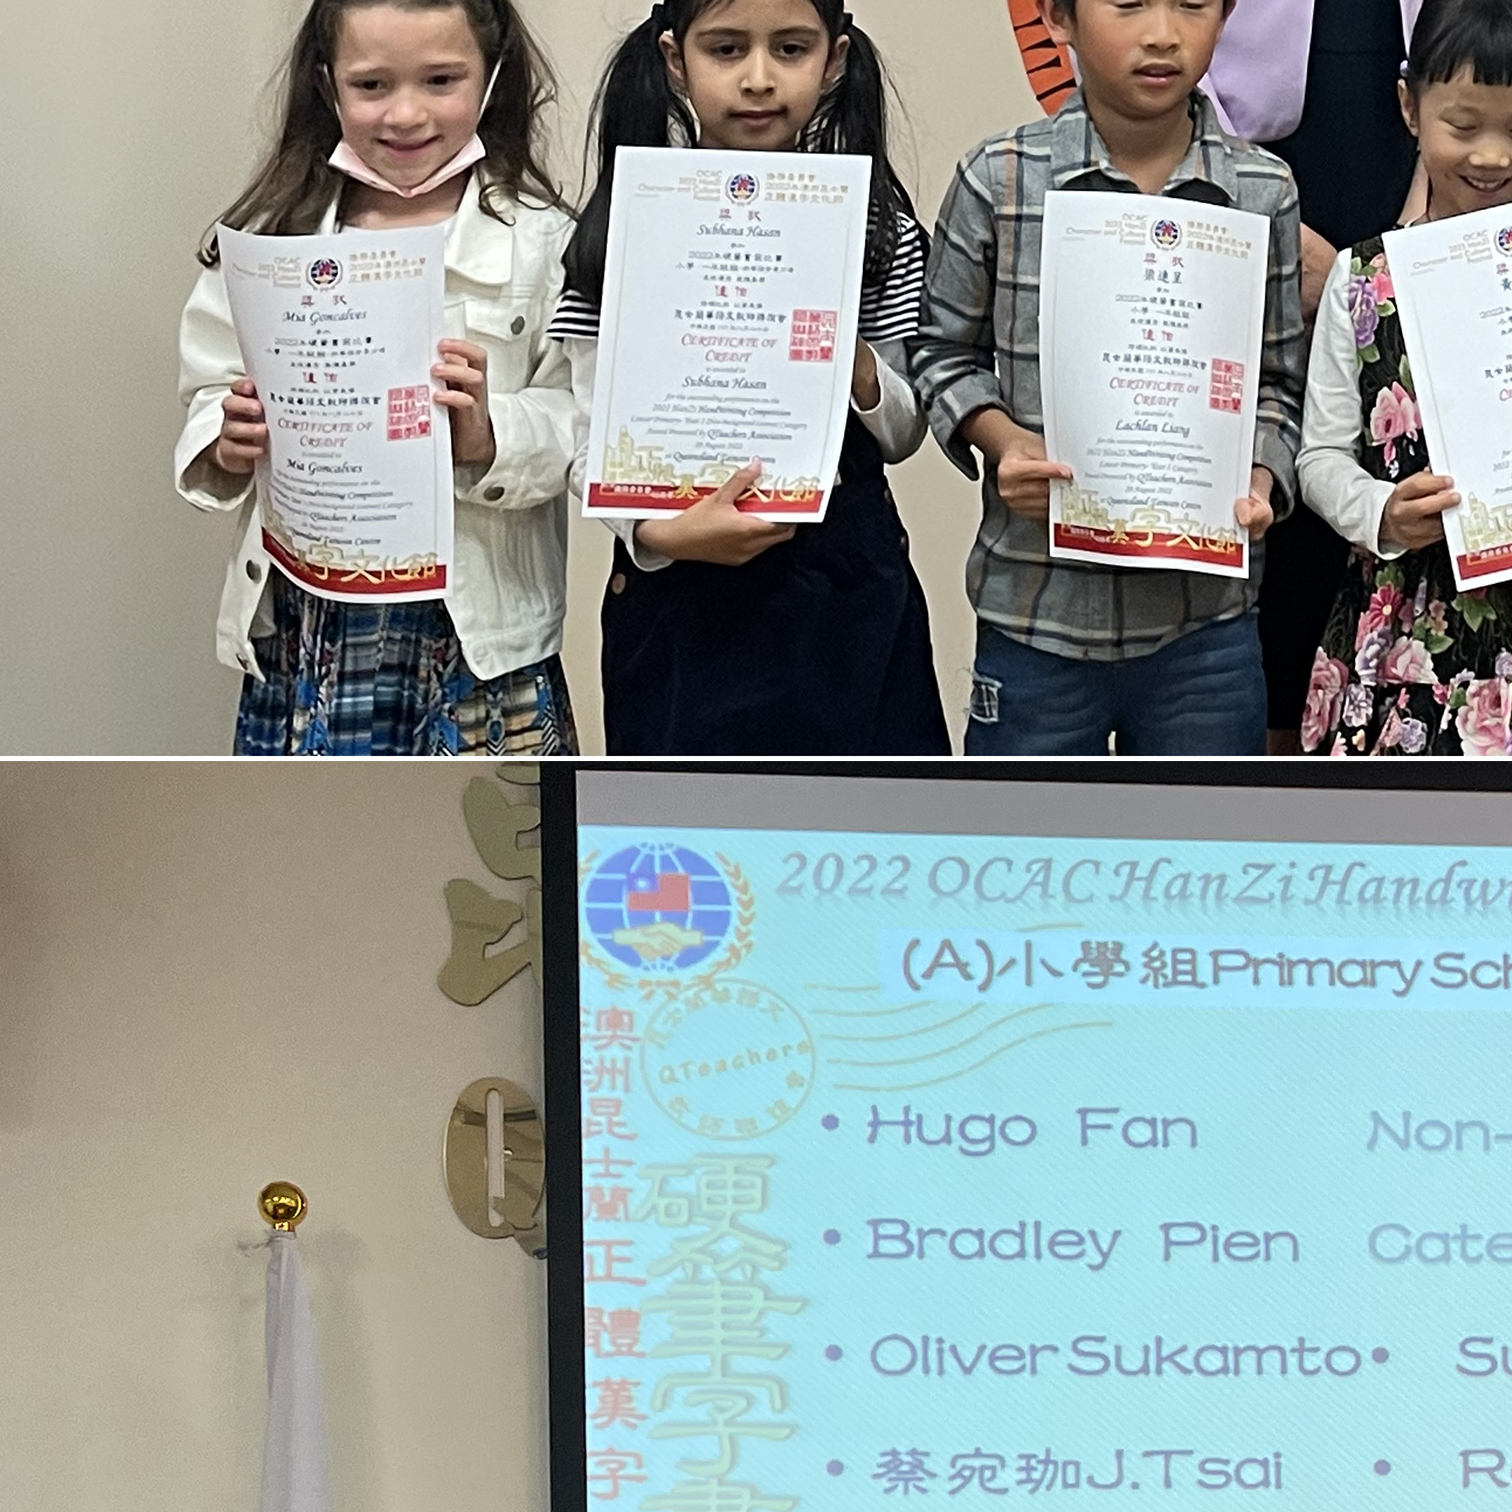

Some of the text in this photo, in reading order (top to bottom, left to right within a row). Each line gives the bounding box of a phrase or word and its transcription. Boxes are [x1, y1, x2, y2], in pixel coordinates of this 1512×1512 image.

[777, 851, 910, 900] 2022
[927, 853, 1096, 903] OCAC
[868, 1105, 1197, 1156] Hugo Fan
[867, 1219, 1300, 1272] Bradley Pien
